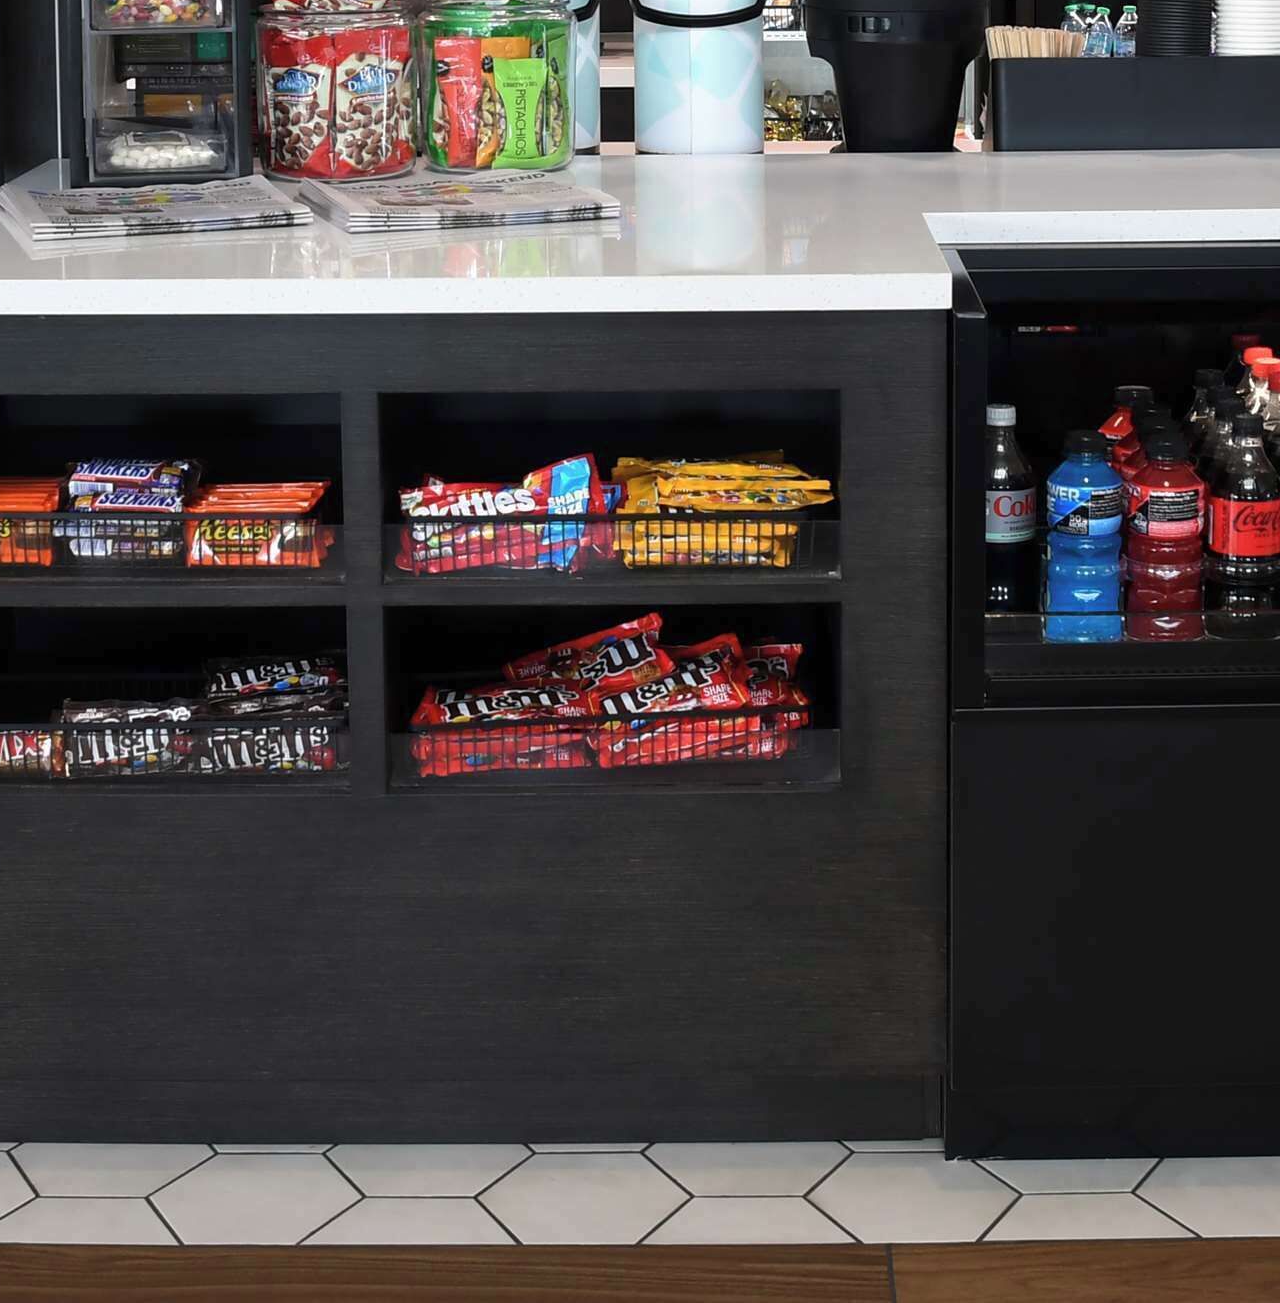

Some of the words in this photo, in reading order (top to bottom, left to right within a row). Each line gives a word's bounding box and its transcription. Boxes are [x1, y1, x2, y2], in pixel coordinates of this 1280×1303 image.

[515, 89, 527, 156] PISTACHIOS
[76, 461, 152, 478] SNICKERS
[98, 493, 178, 507] SNICKERS
[548, 487, 591, 507] SHARE
[409, 488, 537, 530] Skittles
[993, 495, 1034, 518] Cok
[702, 683, 733, 698] SHARE
[712, 694, 730, 705] SIZE
